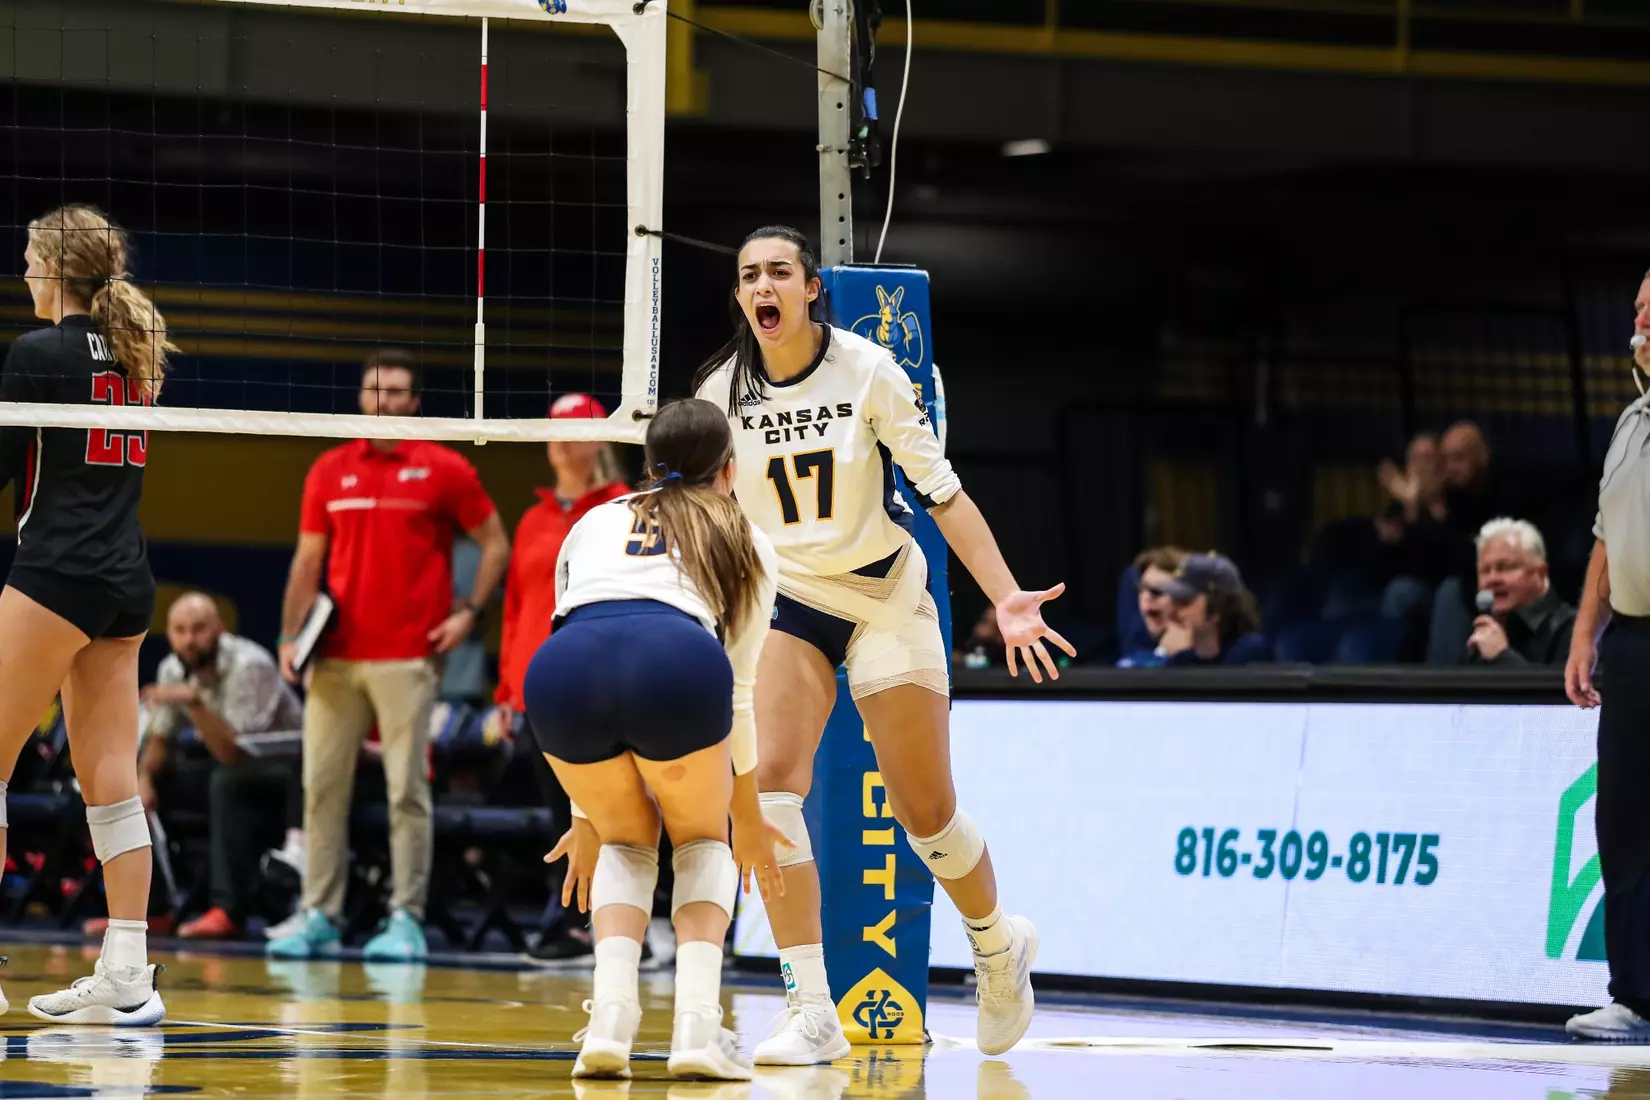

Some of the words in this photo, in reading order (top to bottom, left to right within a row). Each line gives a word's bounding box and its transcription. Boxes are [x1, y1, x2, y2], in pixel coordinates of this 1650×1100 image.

[741, 403, 853, 430] KANSAS
[765, 422, 829, 444] CITY
[765, 447, 835, 526] 17
[862, 771, 897, 959] CITY
[1174, 826, 1440, 886] 816-309-8175
